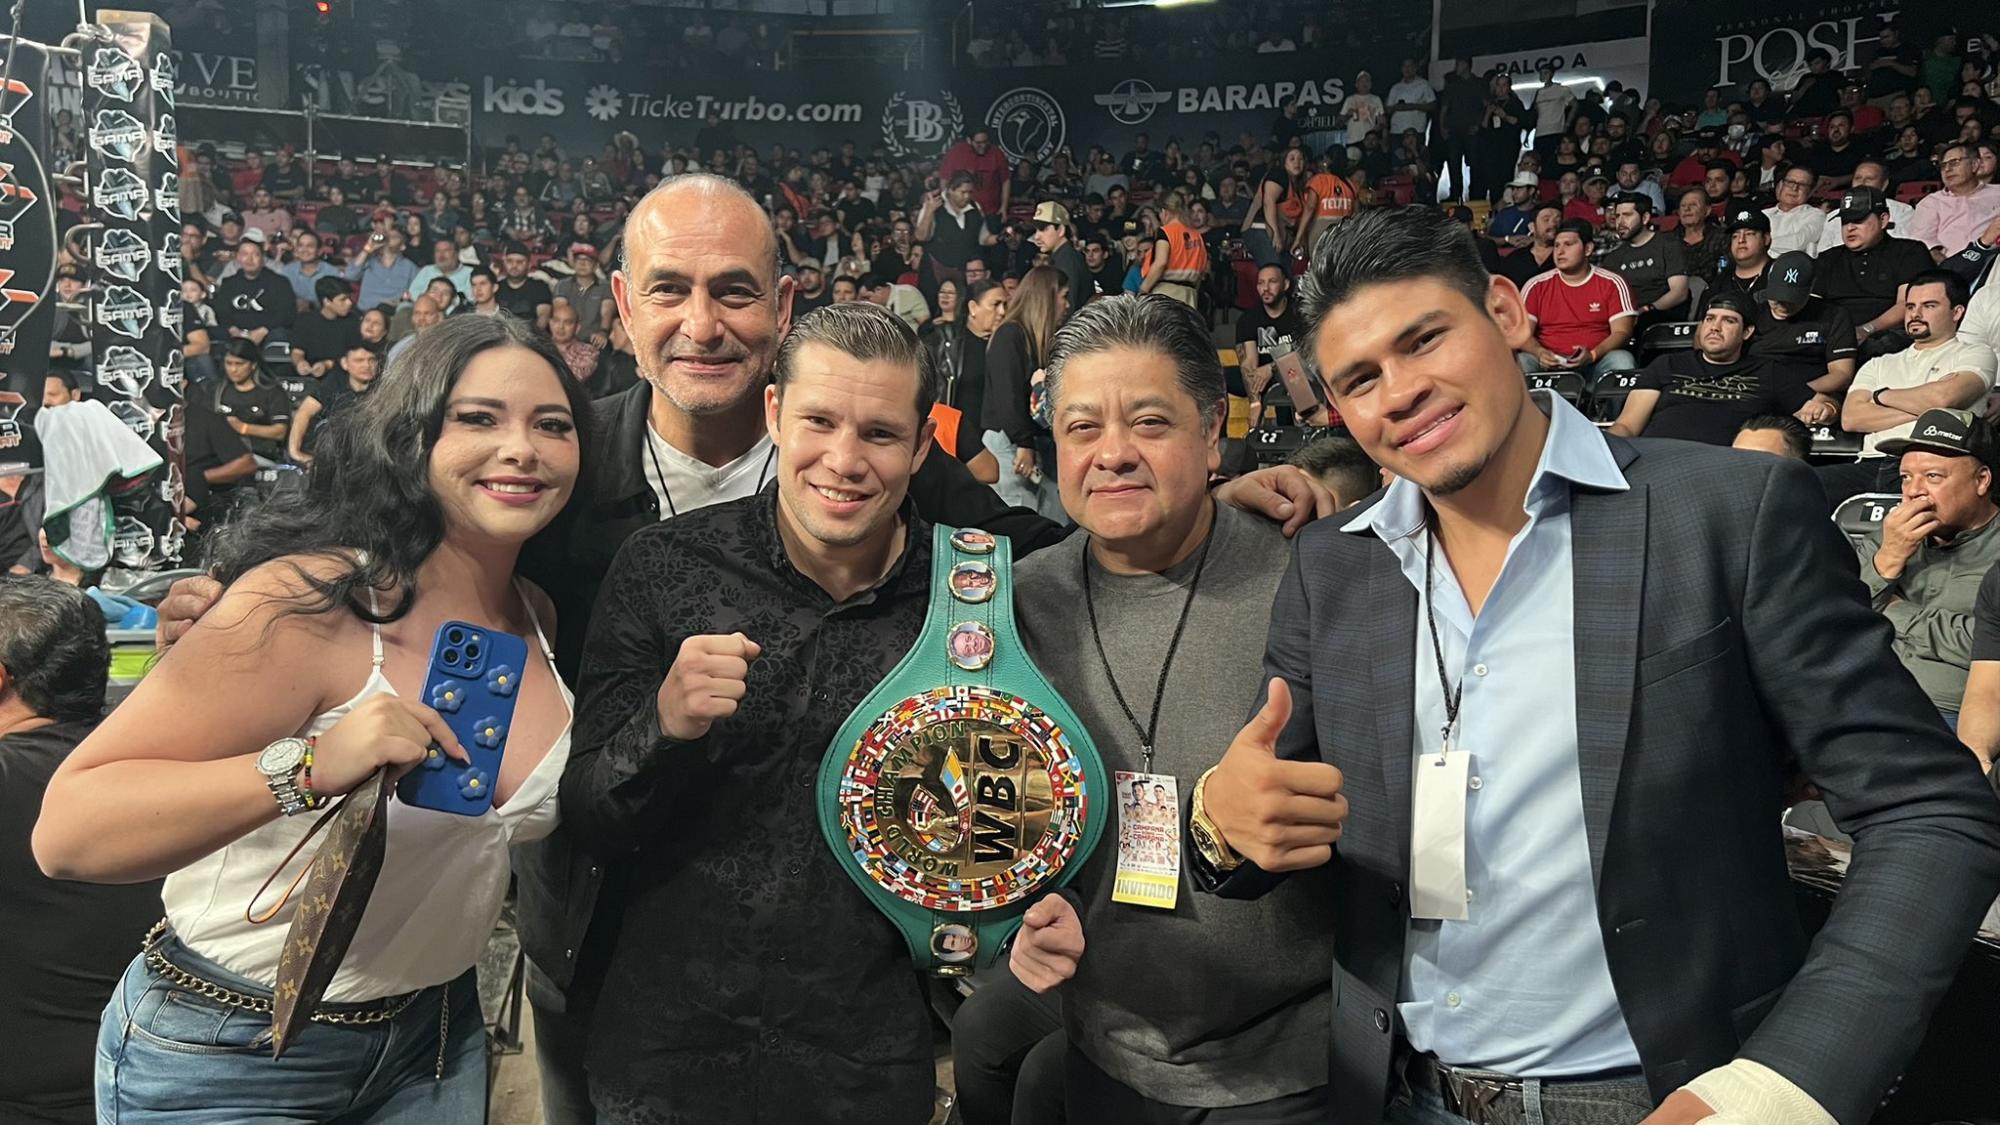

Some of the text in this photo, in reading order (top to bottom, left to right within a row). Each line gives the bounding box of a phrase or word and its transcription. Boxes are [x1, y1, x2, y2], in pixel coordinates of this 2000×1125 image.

[1571, 52, 1587, 69] A
[89, 68, 142, 86] GAMA
[483, 75, 565, 118] kids
[91, 130, 145, 148] GAMA
[94, 188, 148, 206] GAMA
[96, 249, 150, 266] GAMA
[97, 306, 152, 323] GAMA
[98, 366, 153, 383] GAMA
[876, 721, 966, 877] WORLD CHAMPION
[973, 735, 1020, 863] WBC
[1116, 879, 1175, 900] INVITADO
